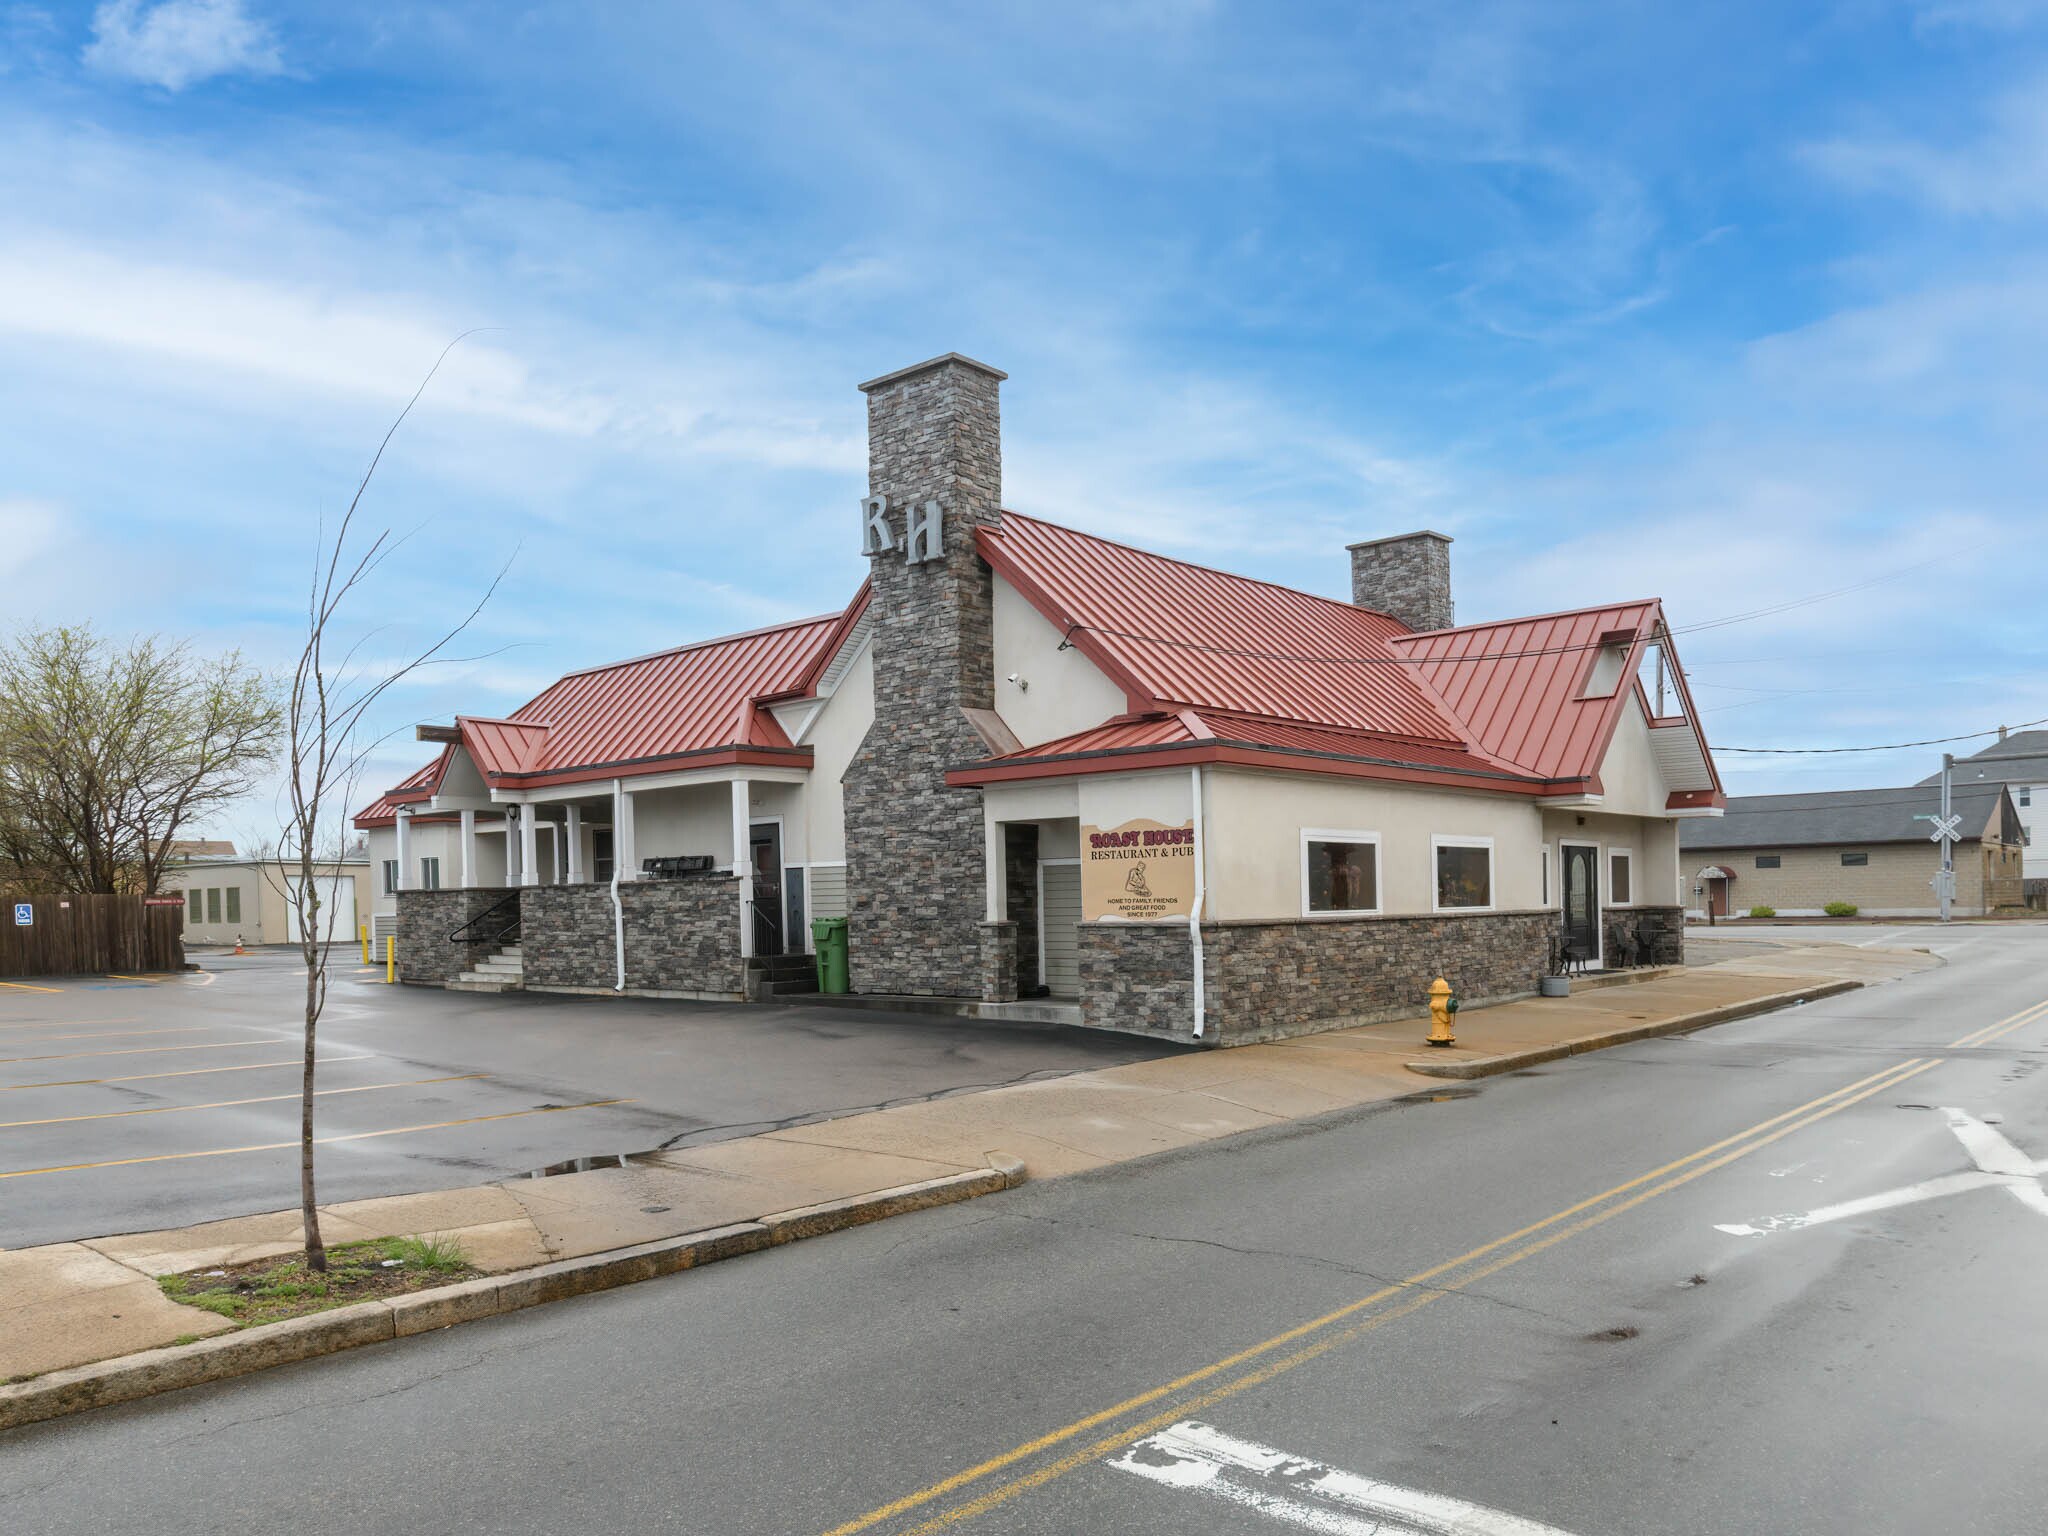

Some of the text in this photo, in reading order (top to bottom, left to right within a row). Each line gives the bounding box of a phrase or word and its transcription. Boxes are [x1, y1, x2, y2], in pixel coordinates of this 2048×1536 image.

[1090, 829, 1194, 848] ROAST HOUSE
[1091, 847, 1194, 860] RESTAURANT & PUB
